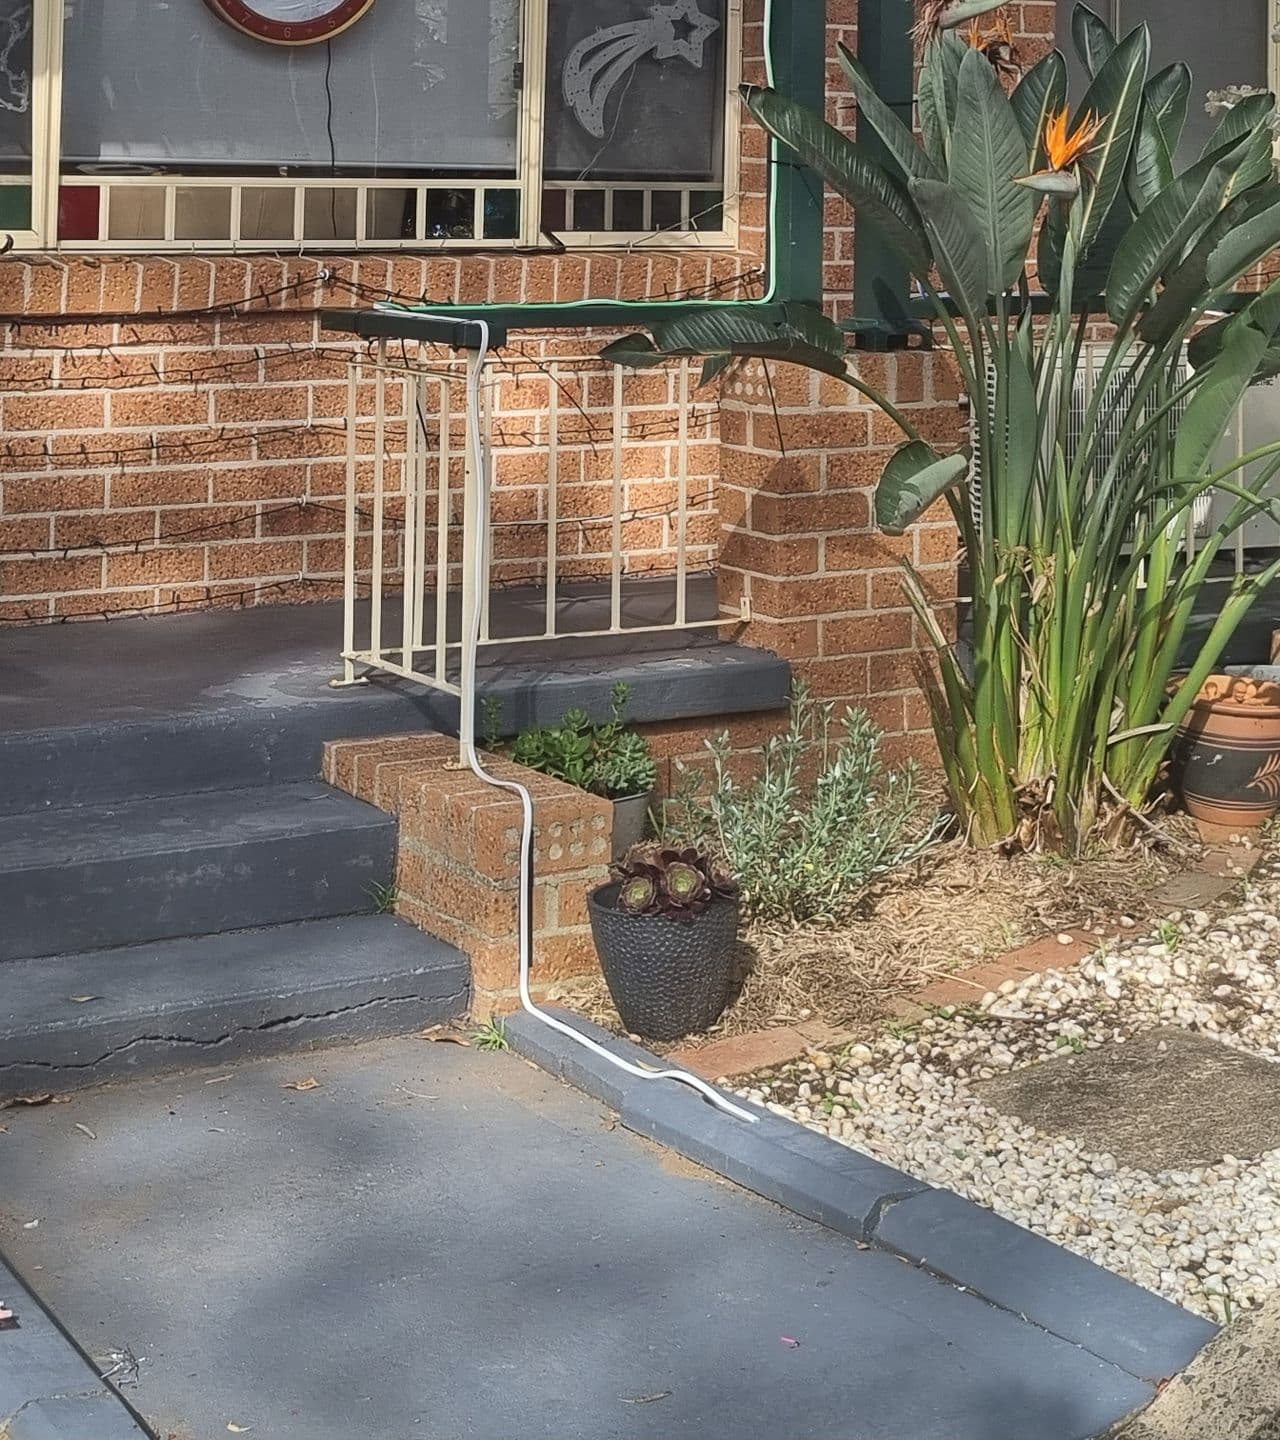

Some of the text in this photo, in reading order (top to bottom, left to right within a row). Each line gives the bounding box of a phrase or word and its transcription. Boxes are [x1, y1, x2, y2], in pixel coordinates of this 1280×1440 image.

[240, 12, 252, 24] 7
[328, 18, 337, 29] 5
[284, 26, 292, 39] 6
